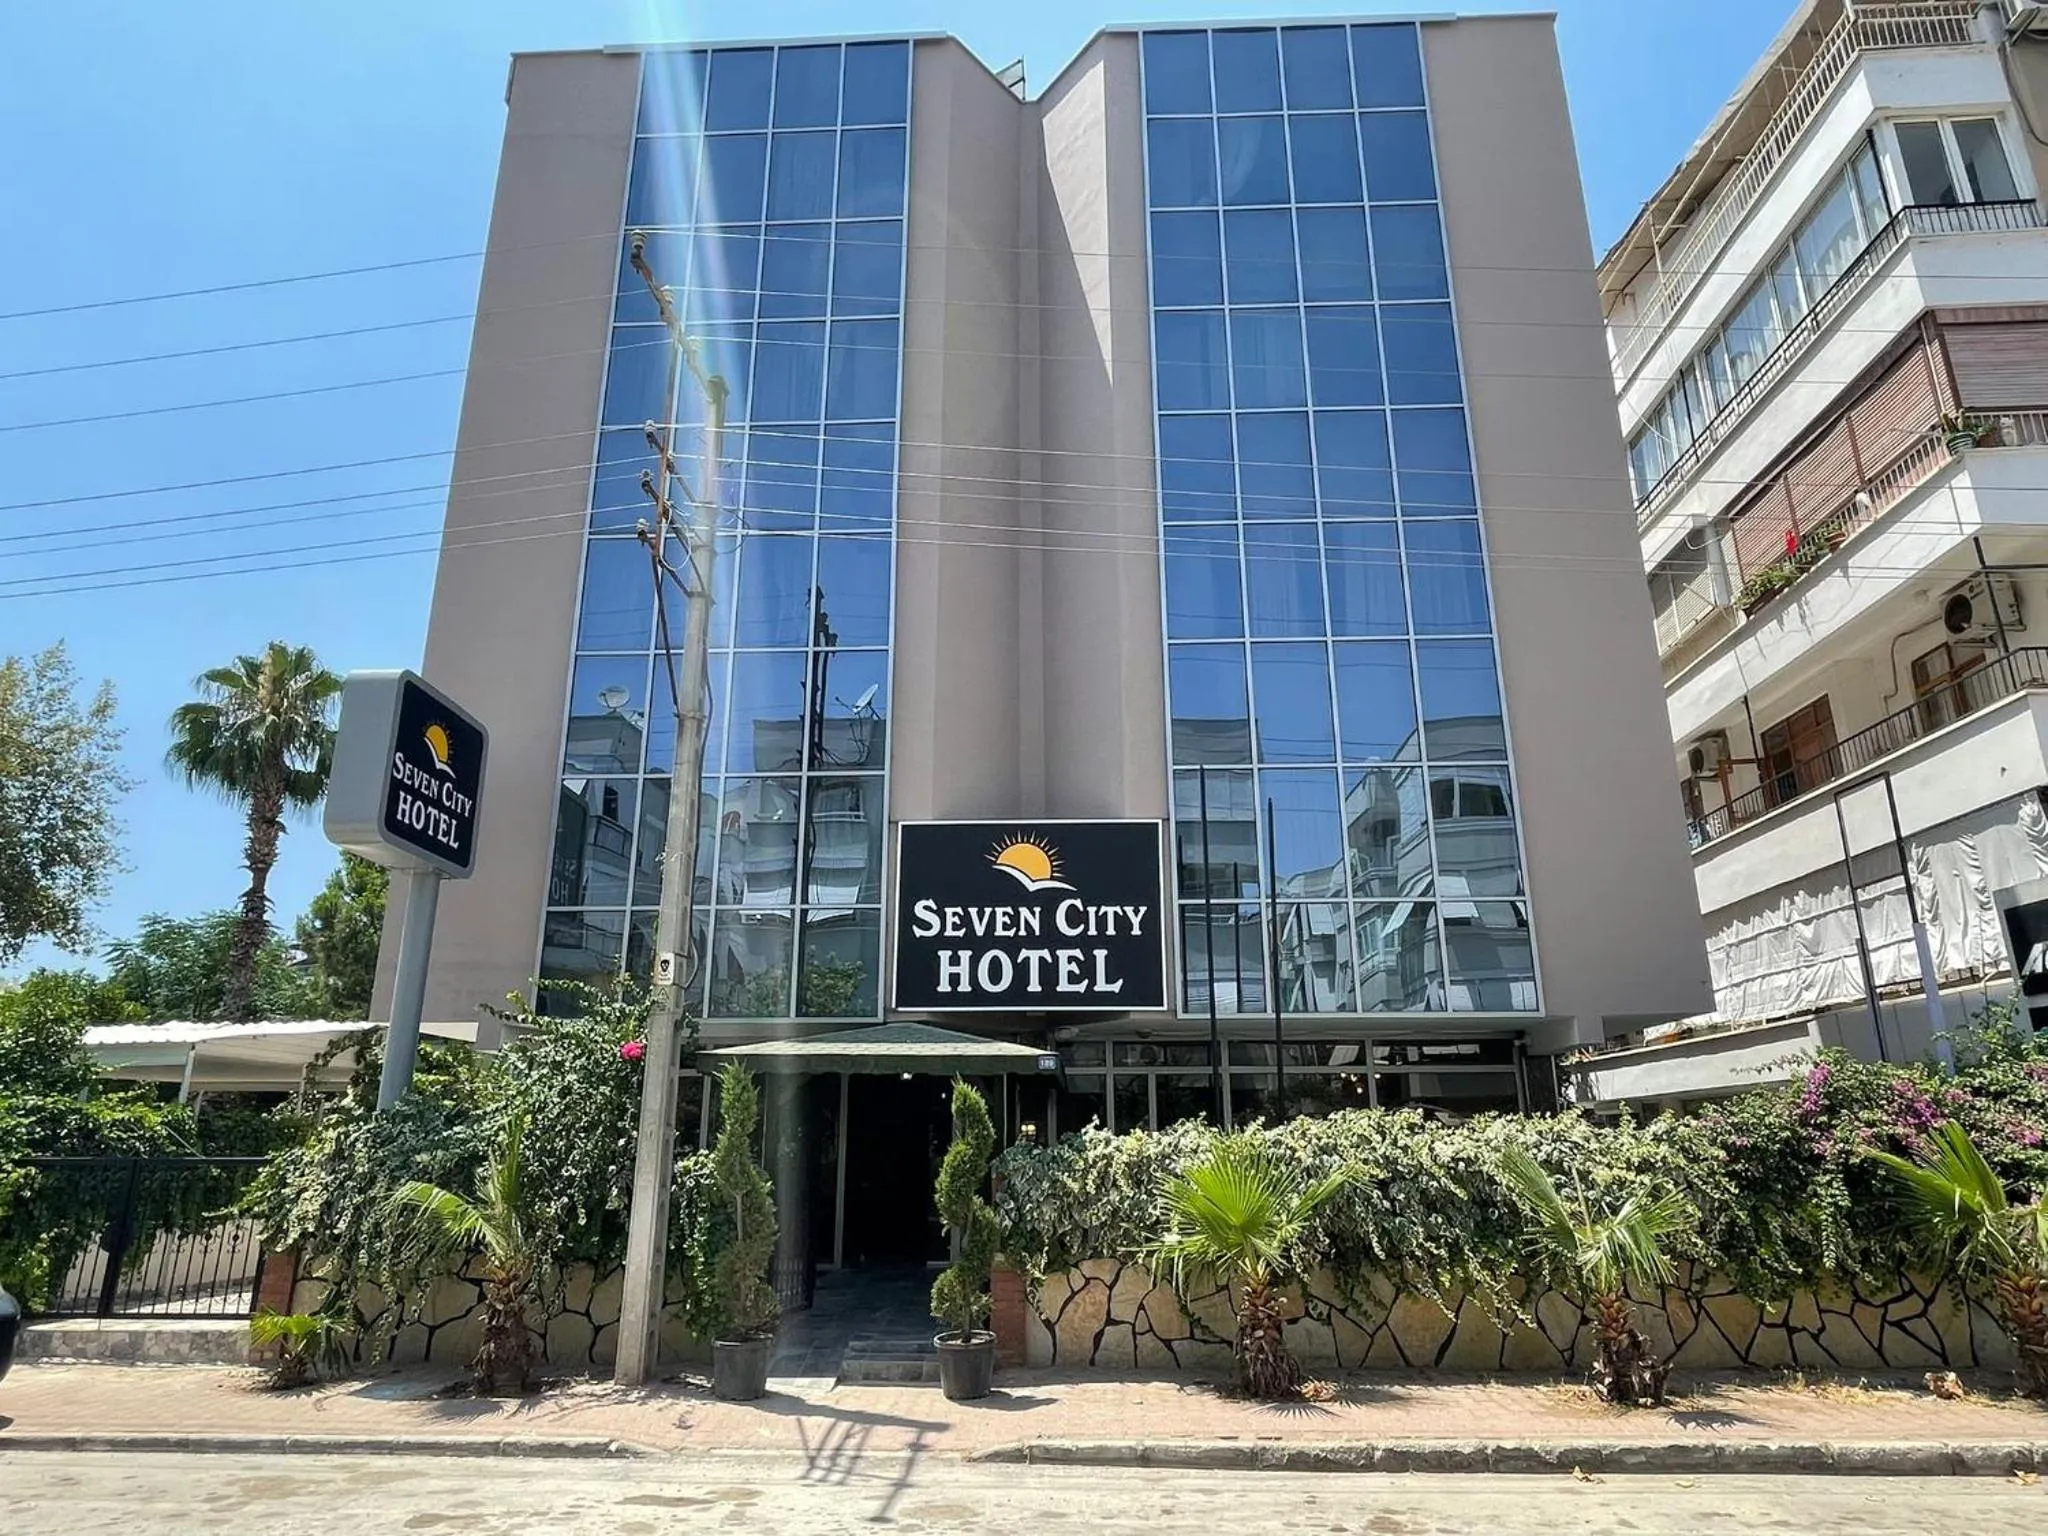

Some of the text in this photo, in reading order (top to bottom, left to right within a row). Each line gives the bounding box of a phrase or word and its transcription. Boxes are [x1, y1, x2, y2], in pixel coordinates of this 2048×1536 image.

[393, 752, 472, 817] SEVEN CITY
[397, 791, 460, 849] HOTEL
[912, 898, 1147, 937] SEVEN CITY
[937, 948, 1123, 993] HOTEL
